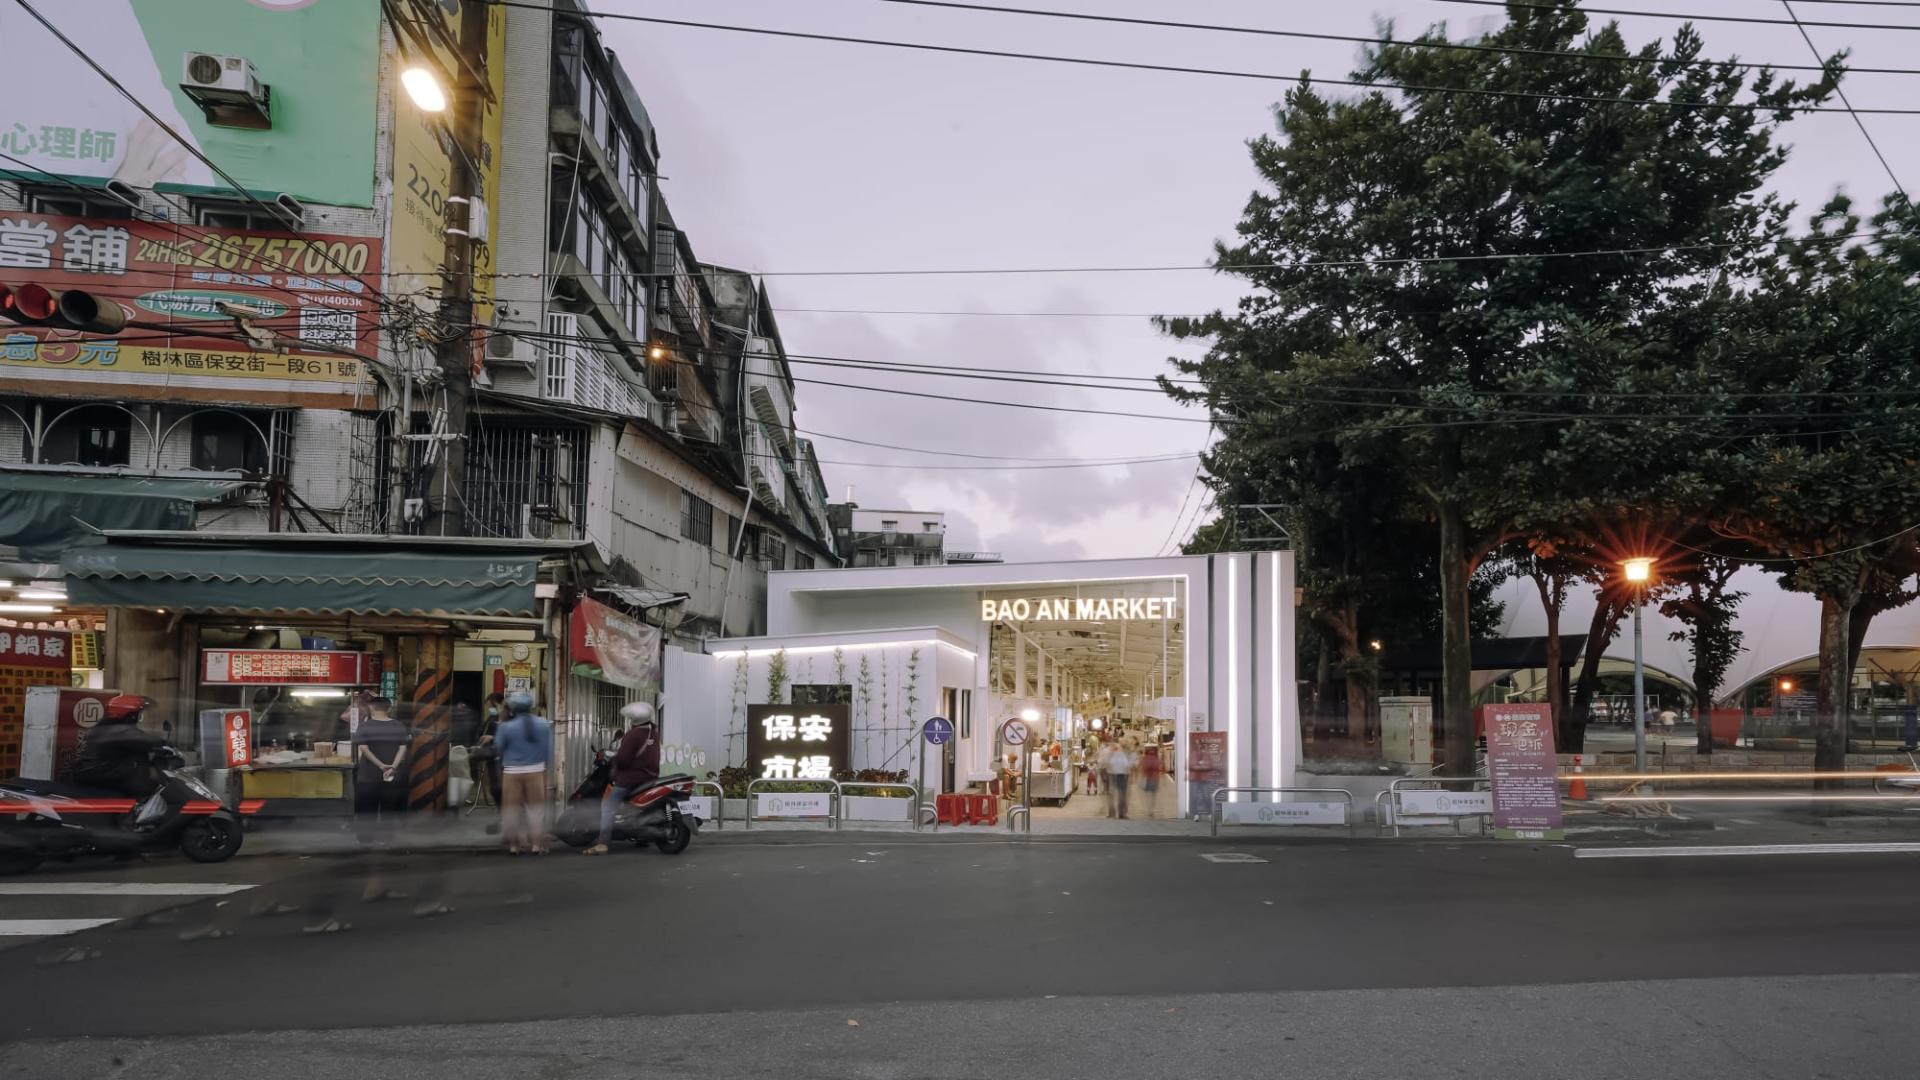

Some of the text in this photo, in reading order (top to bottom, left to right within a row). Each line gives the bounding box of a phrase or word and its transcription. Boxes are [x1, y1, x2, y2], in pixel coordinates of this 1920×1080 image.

[0, 122, 117, 163] 心理師
[0, 218, 130, 275] 當舖
[193, 233, 369, 275] 26757000
[141, 349, 357, 377] 樹林區保安街一段61號
[982, 597, 1177, 621] BAO AN MARKET
[761, 714, 833, 742] 保安
[1499, 721, 1538, 738] 現金
[761, 755, 833, 779] 市場
